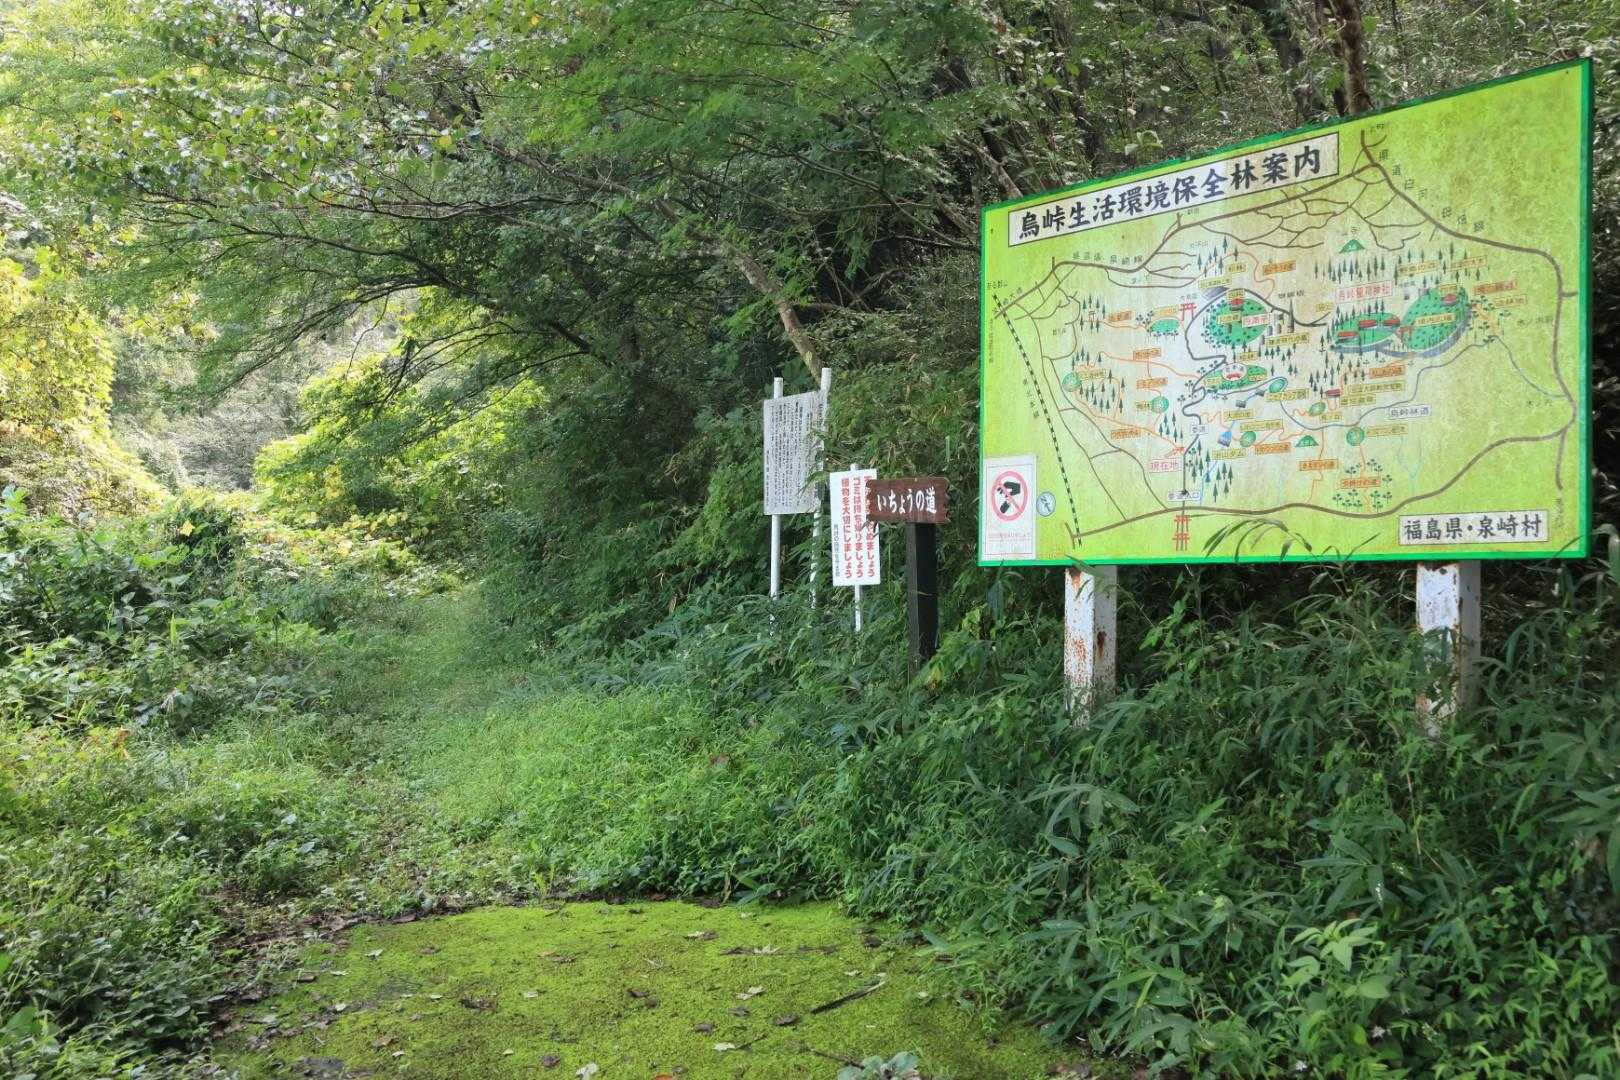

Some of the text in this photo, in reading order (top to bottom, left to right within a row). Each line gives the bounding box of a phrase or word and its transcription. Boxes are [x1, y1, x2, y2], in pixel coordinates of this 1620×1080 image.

[876, 485, 937, 514] いちょうの道
[1404, 513, 1542, 540] 福島県・泉崎村
